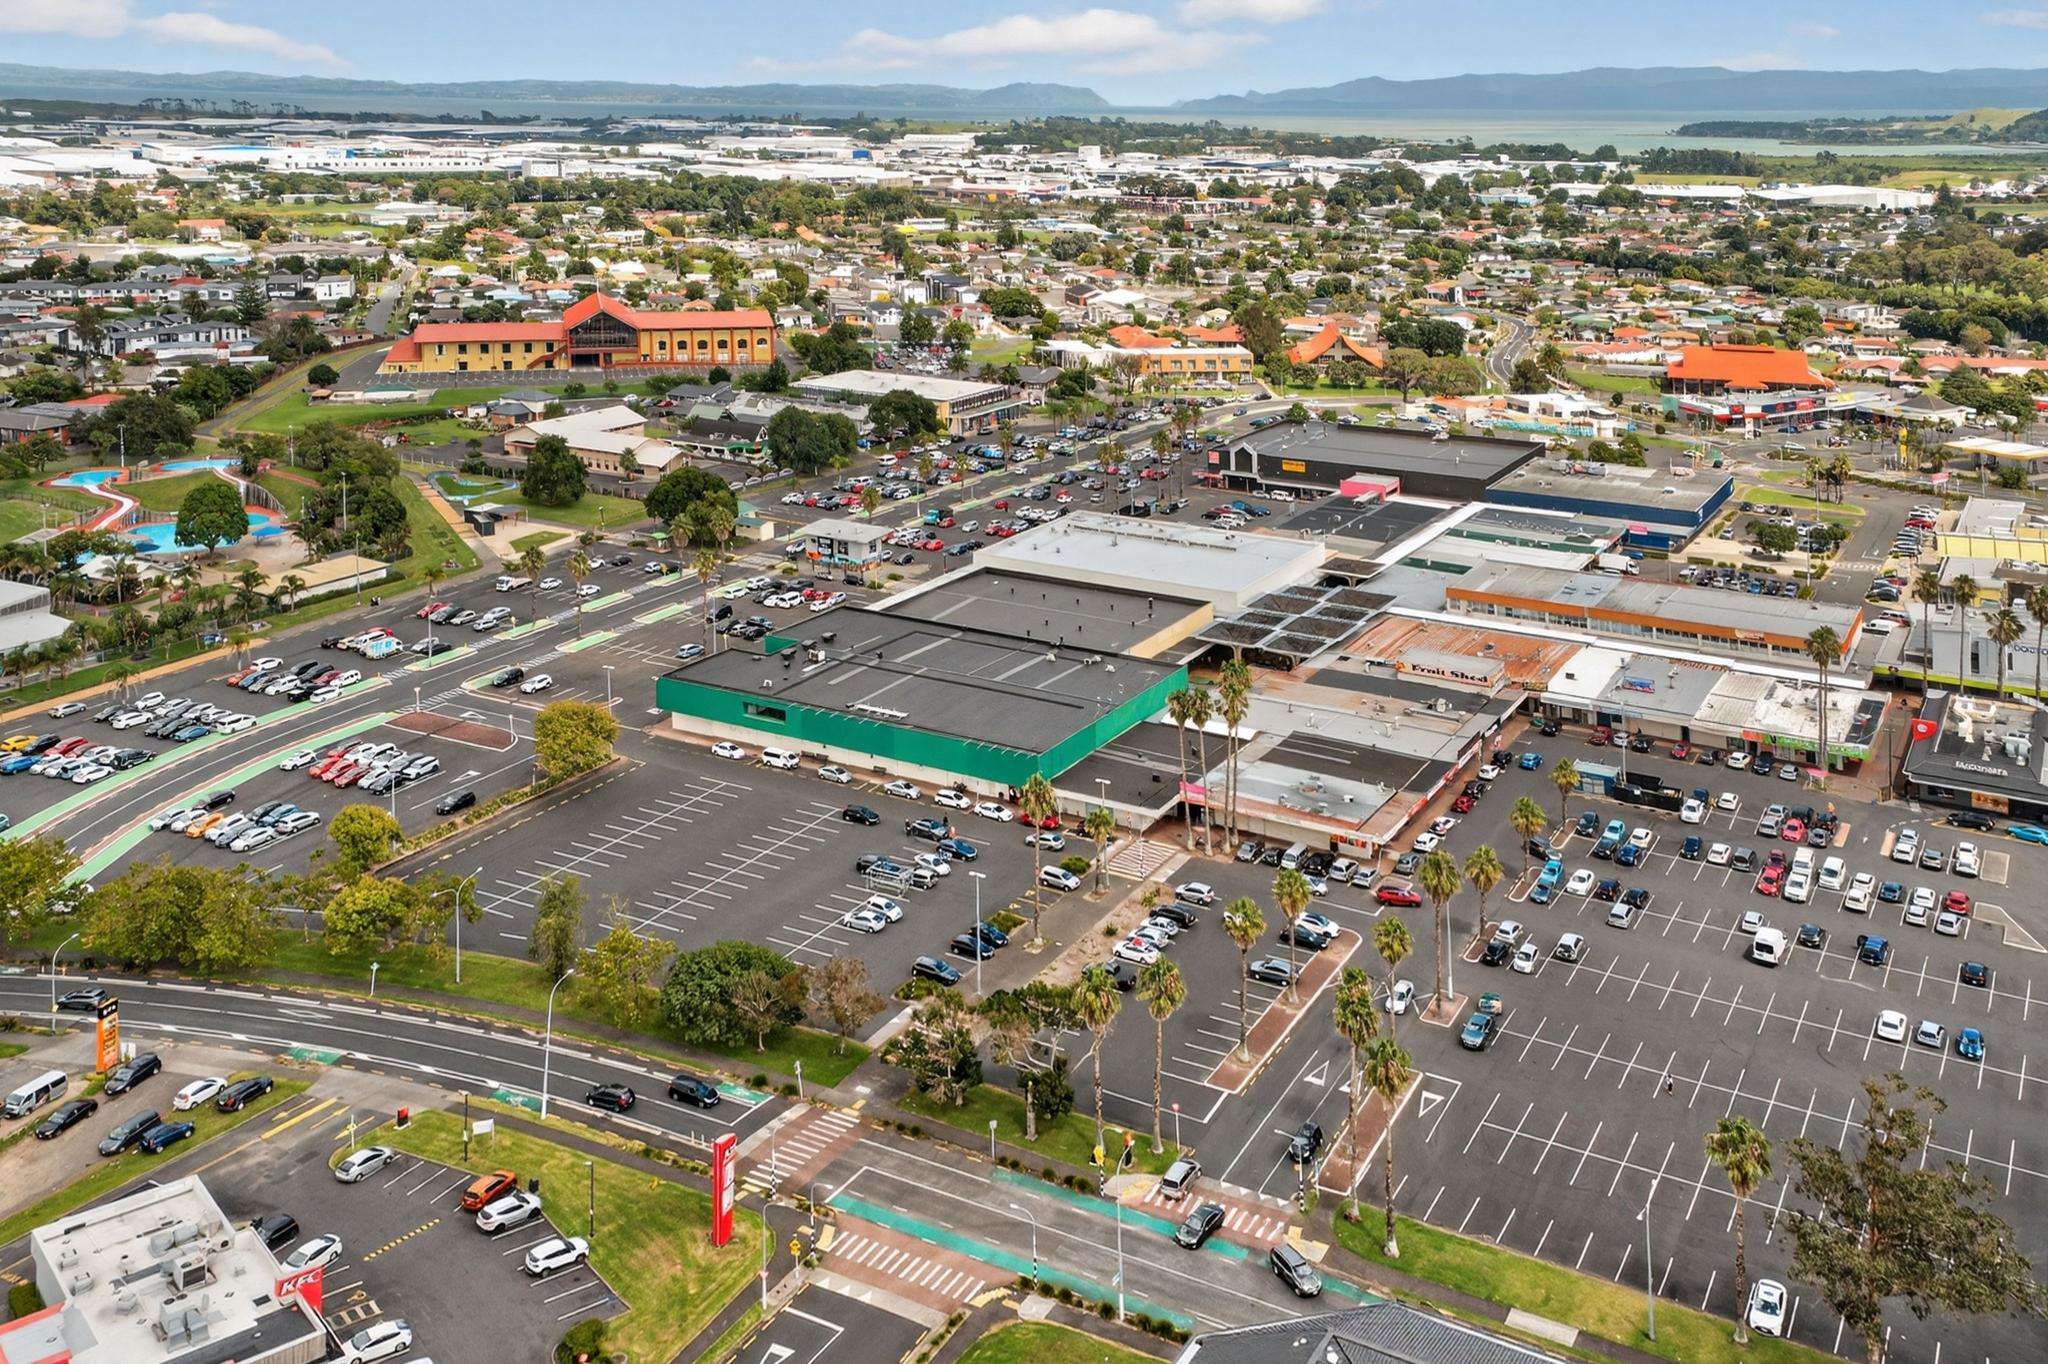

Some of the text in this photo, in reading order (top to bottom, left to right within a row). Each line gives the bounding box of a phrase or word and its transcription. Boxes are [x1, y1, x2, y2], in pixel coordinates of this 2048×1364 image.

[1411, 663, 1488, 682] Fruit Shed
[281, 1269, 321, 1296] KFC
